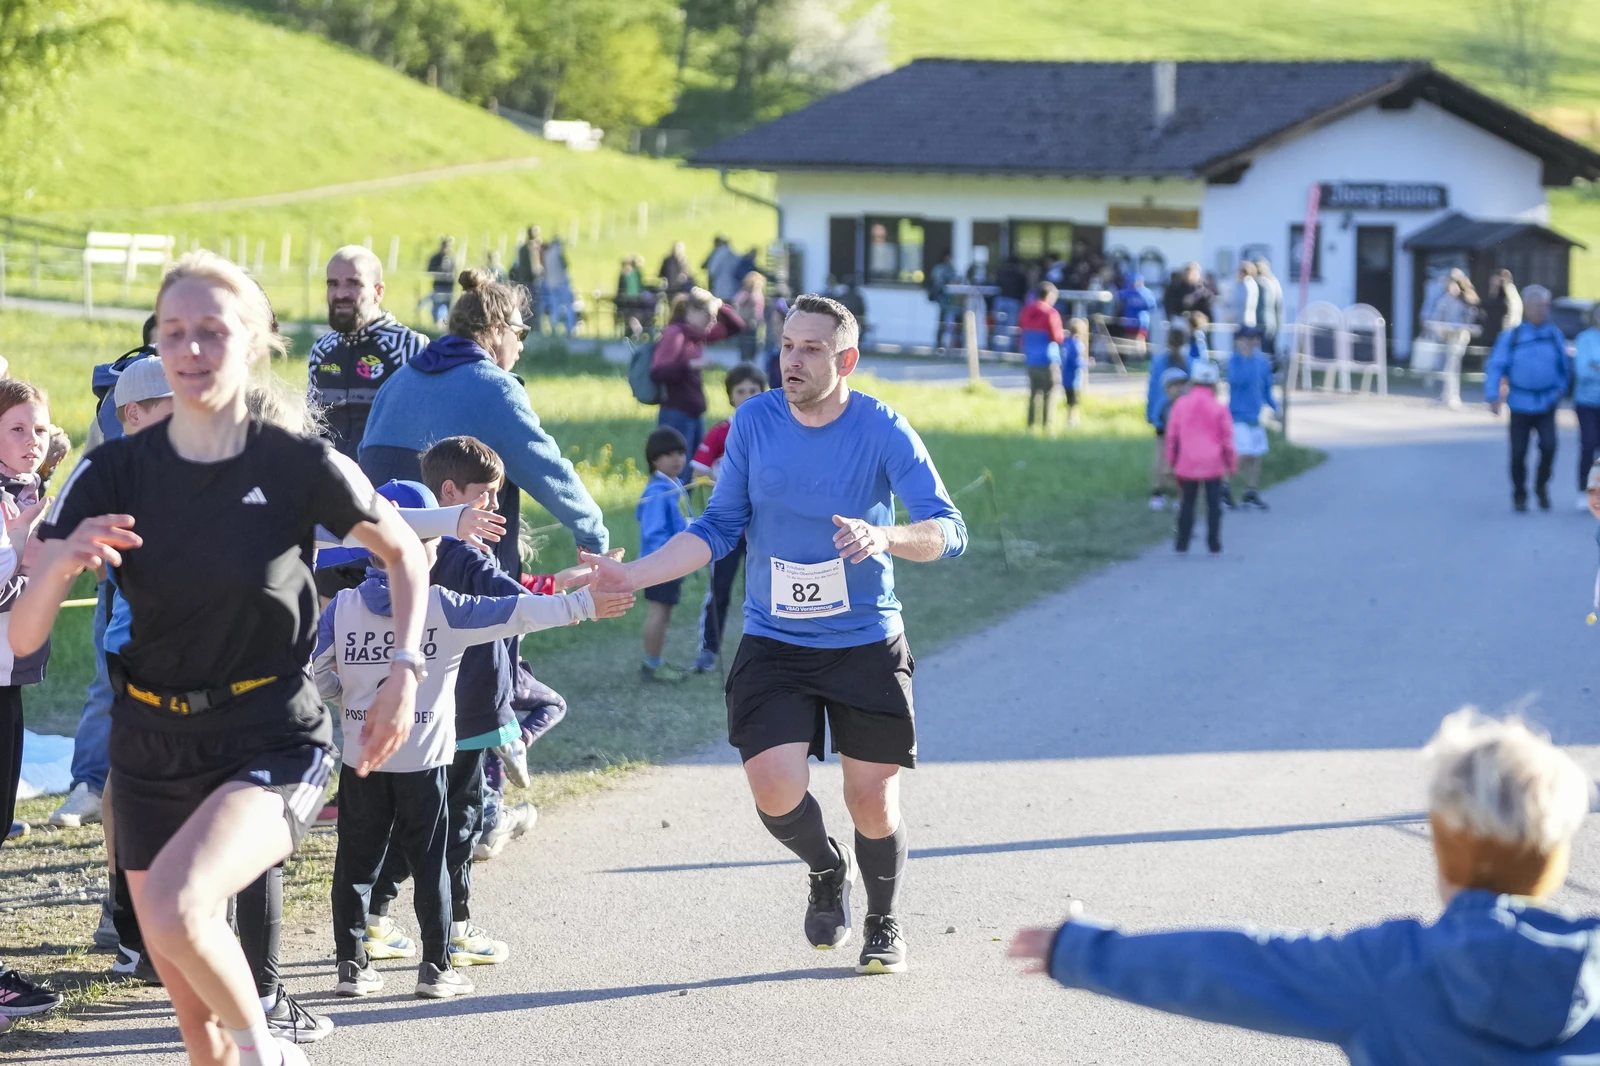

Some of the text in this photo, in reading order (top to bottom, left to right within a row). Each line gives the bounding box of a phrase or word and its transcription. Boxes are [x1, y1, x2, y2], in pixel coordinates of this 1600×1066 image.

[792, 583, 822, 603] 82
[800, 604, 833, 612] Voralpencup
[346, 627, 438, 647] SPOT
